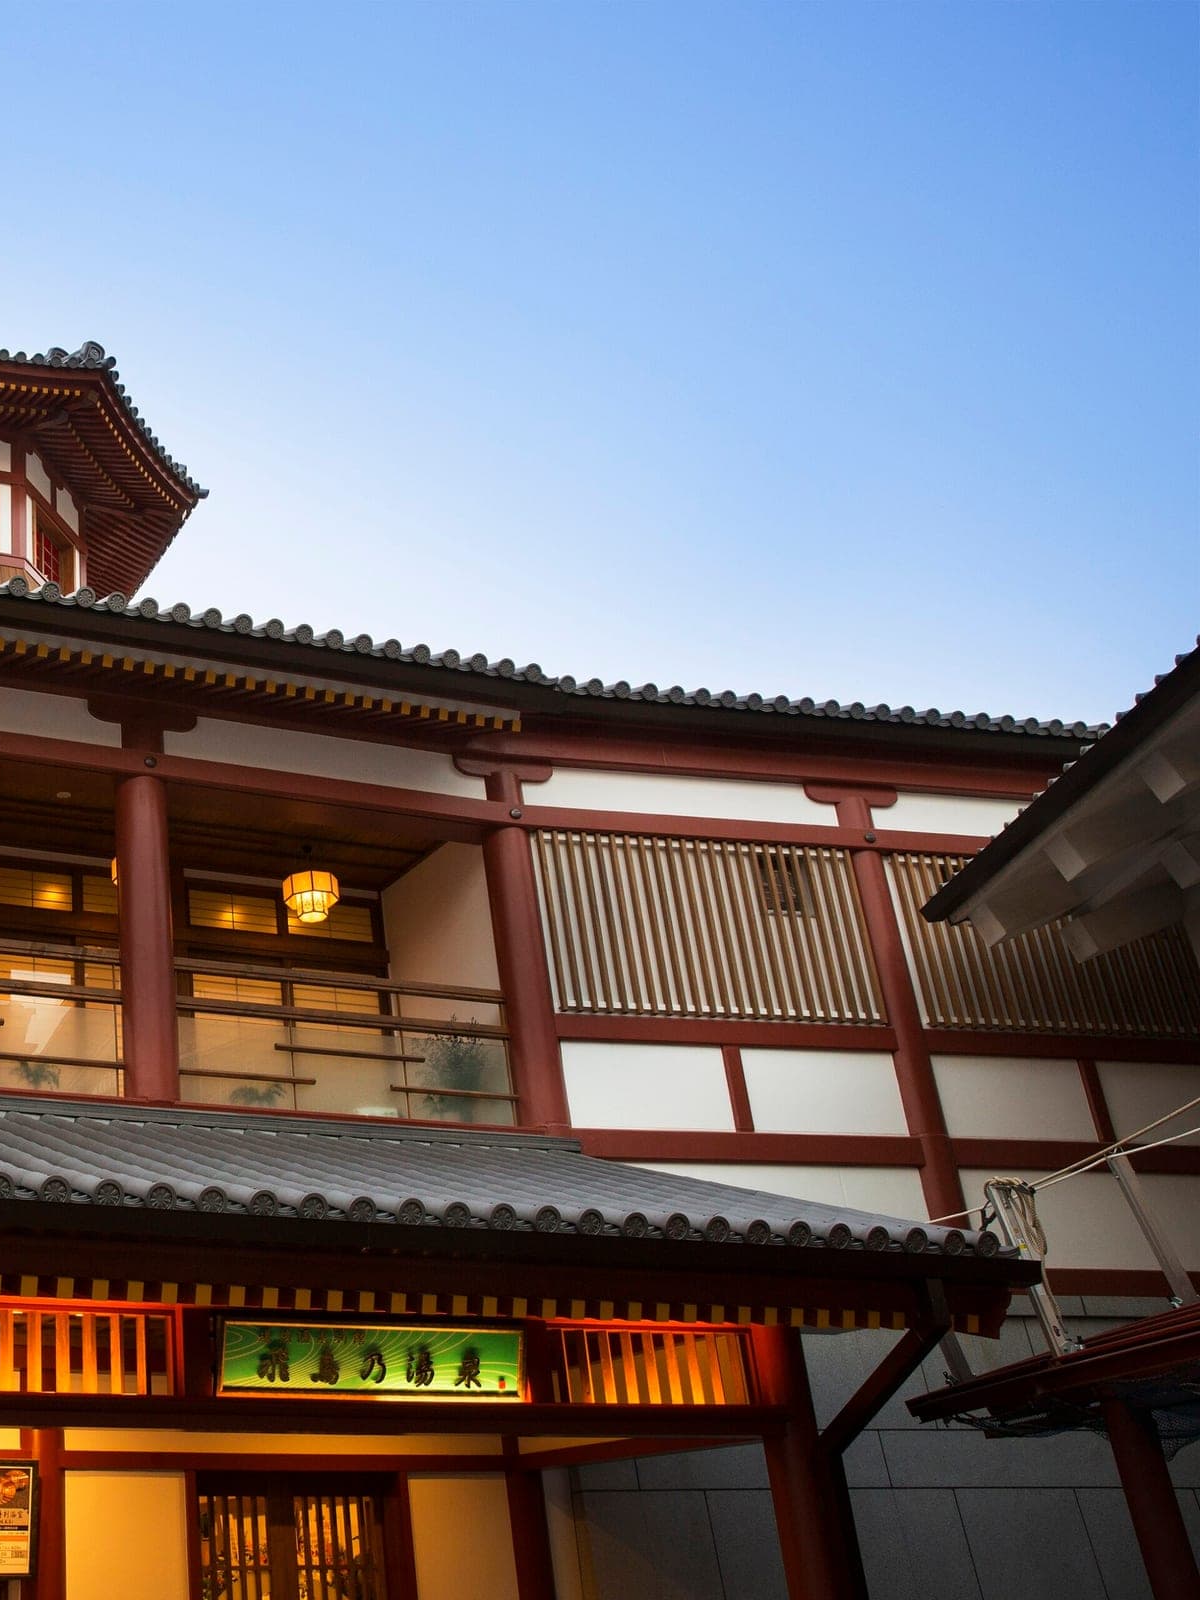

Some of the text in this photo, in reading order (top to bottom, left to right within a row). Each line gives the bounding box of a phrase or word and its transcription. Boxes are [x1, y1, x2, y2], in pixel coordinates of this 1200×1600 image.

[256, 1342, 482, 1389] 飛鳥乃湯泉
